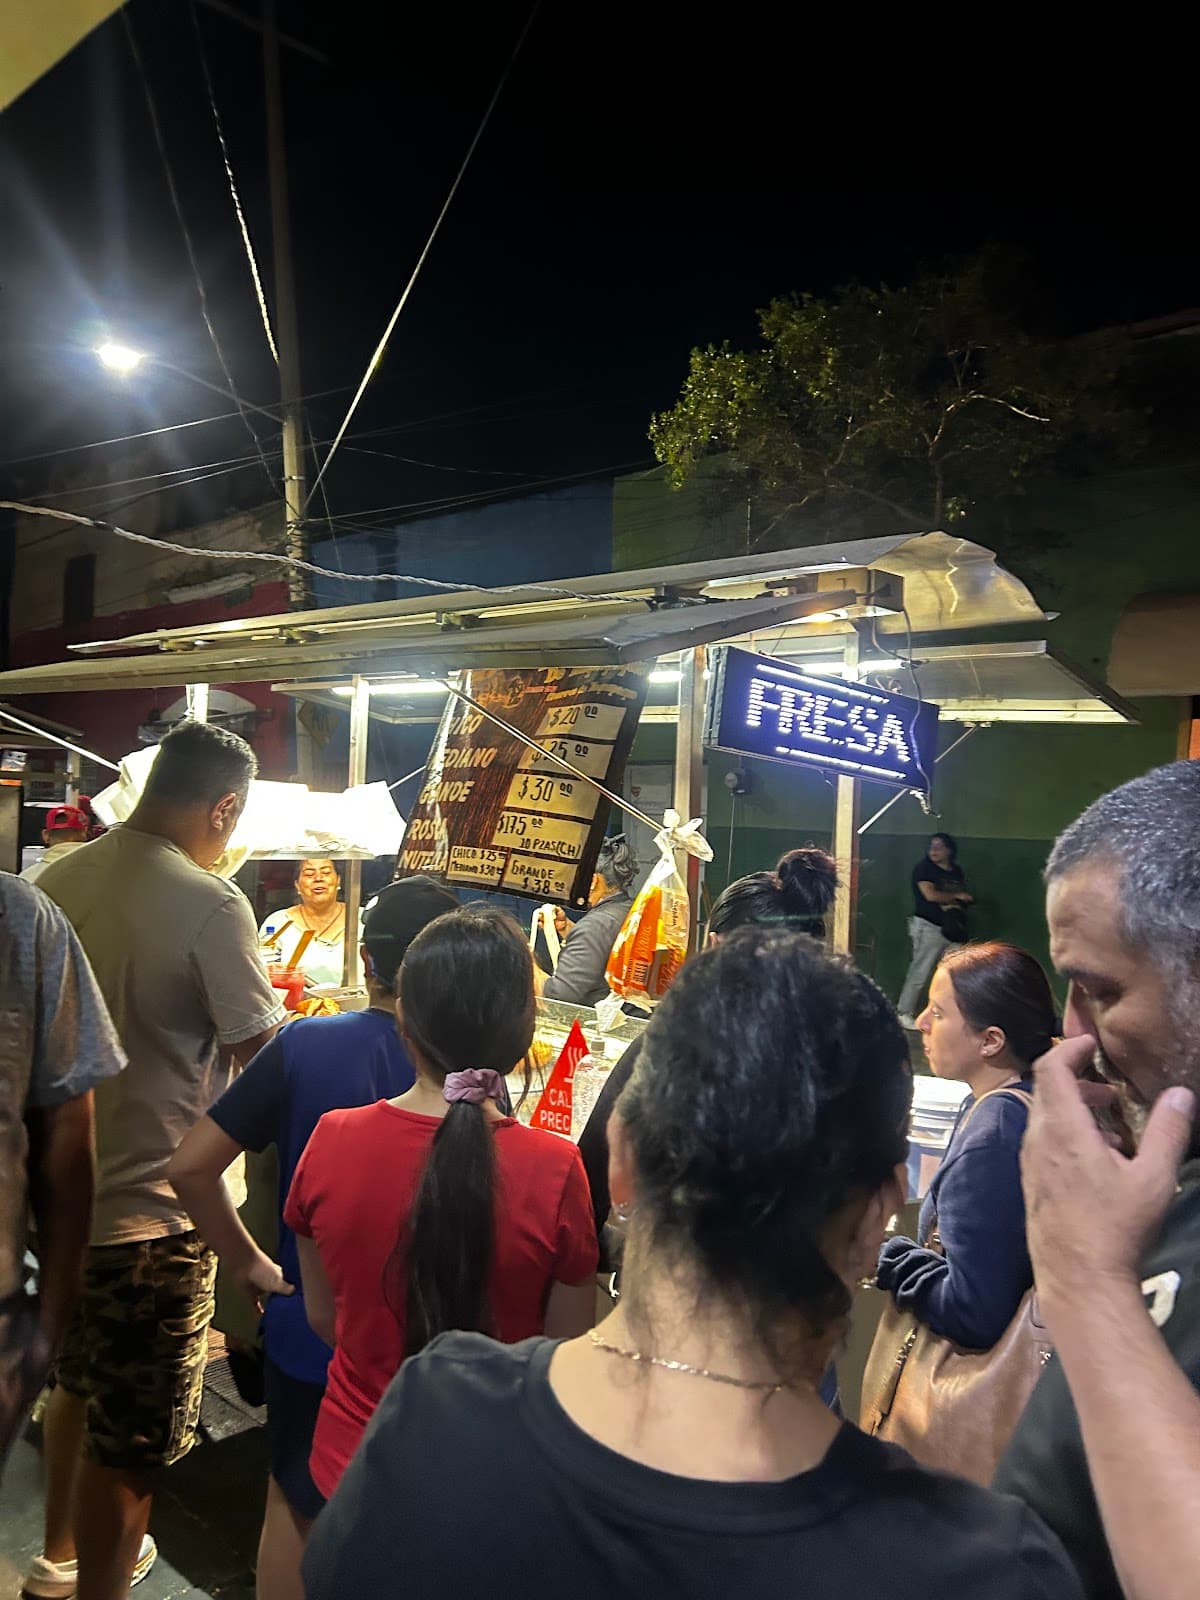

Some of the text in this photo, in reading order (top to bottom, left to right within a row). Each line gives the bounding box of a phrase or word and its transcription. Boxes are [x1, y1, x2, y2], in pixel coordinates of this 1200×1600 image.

[746, 678, 911, 763] FRESA
[452, 847, 477, 859] CHICO
[511, 860, 555, 879] GRANDE
[549, 1087, 572, 1109] CAL
[540, 1109, 570, 1132] PREC
